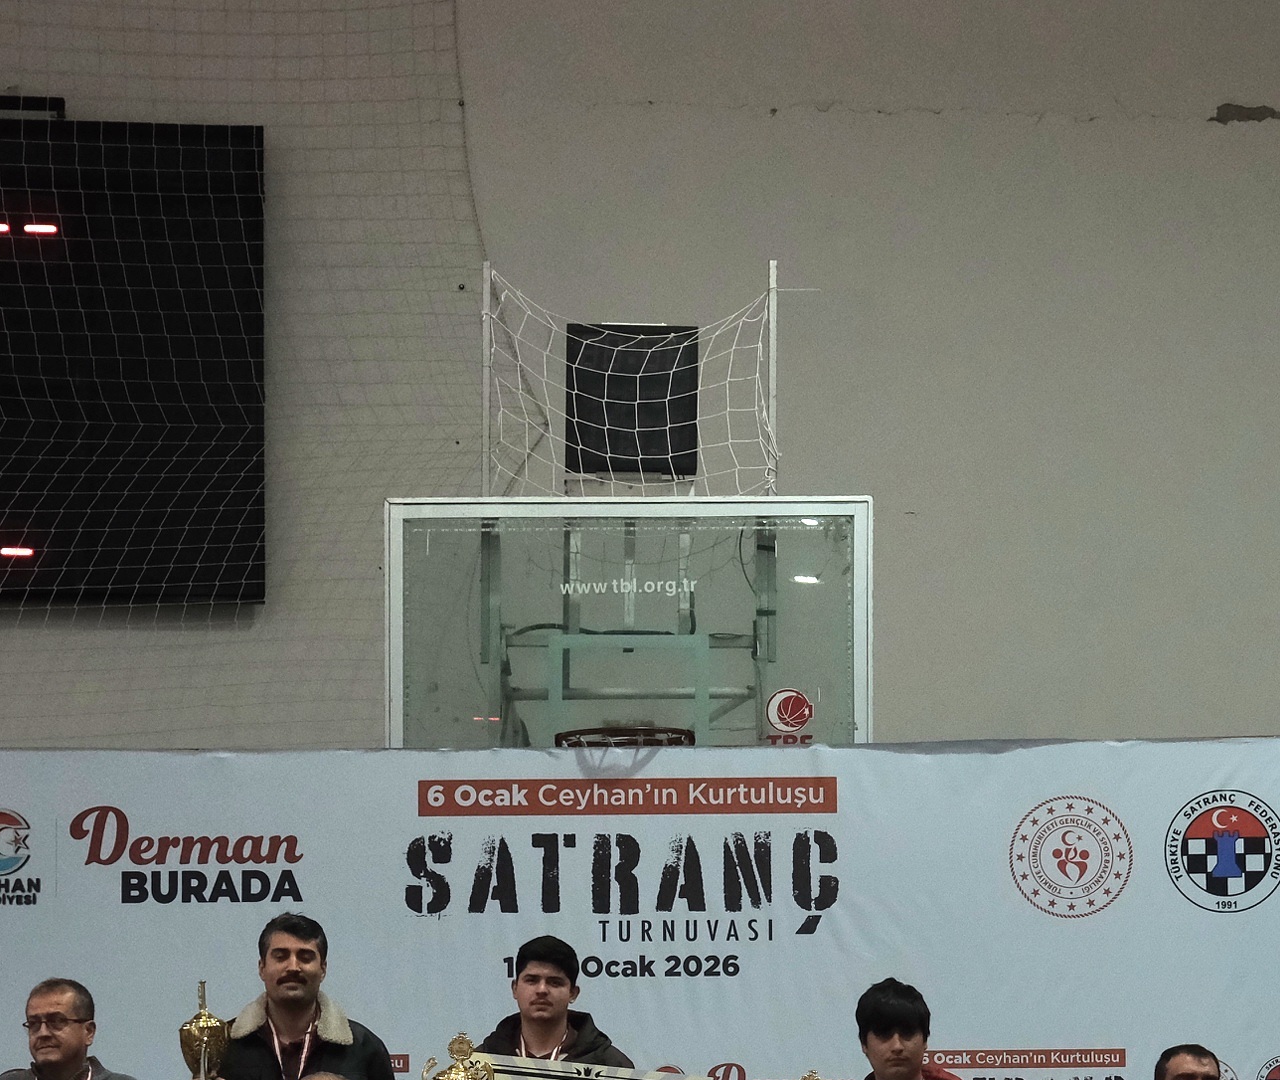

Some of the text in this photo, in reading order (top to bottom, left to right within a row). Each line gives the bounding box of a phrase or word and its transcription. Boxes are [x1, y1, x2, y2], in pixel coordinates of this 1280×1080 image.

[427, 782, 825, 811] 6 Ocak Ceyhan'ın Kurtuluşu
[69, 805, 304, 865] Derman
[1169, 828, 1183, 882] TÜRKİYE
[1183, 793, 1236, 820] SATRANÇ
[120, 869, 304, 904] BURADA
[404, 828, 839, 934] SATRANÇ
[1215, 900, 1238, 910] 1991
[598, 918, 774, 942] TURNUVASI
[581, 954, 655, 978] Ocak
[664, 954, 740, 977] 2026
[933, 1052, 972, 1065] Ocak
[1051, 1051, 1120, 1066] Kurtuluşu
